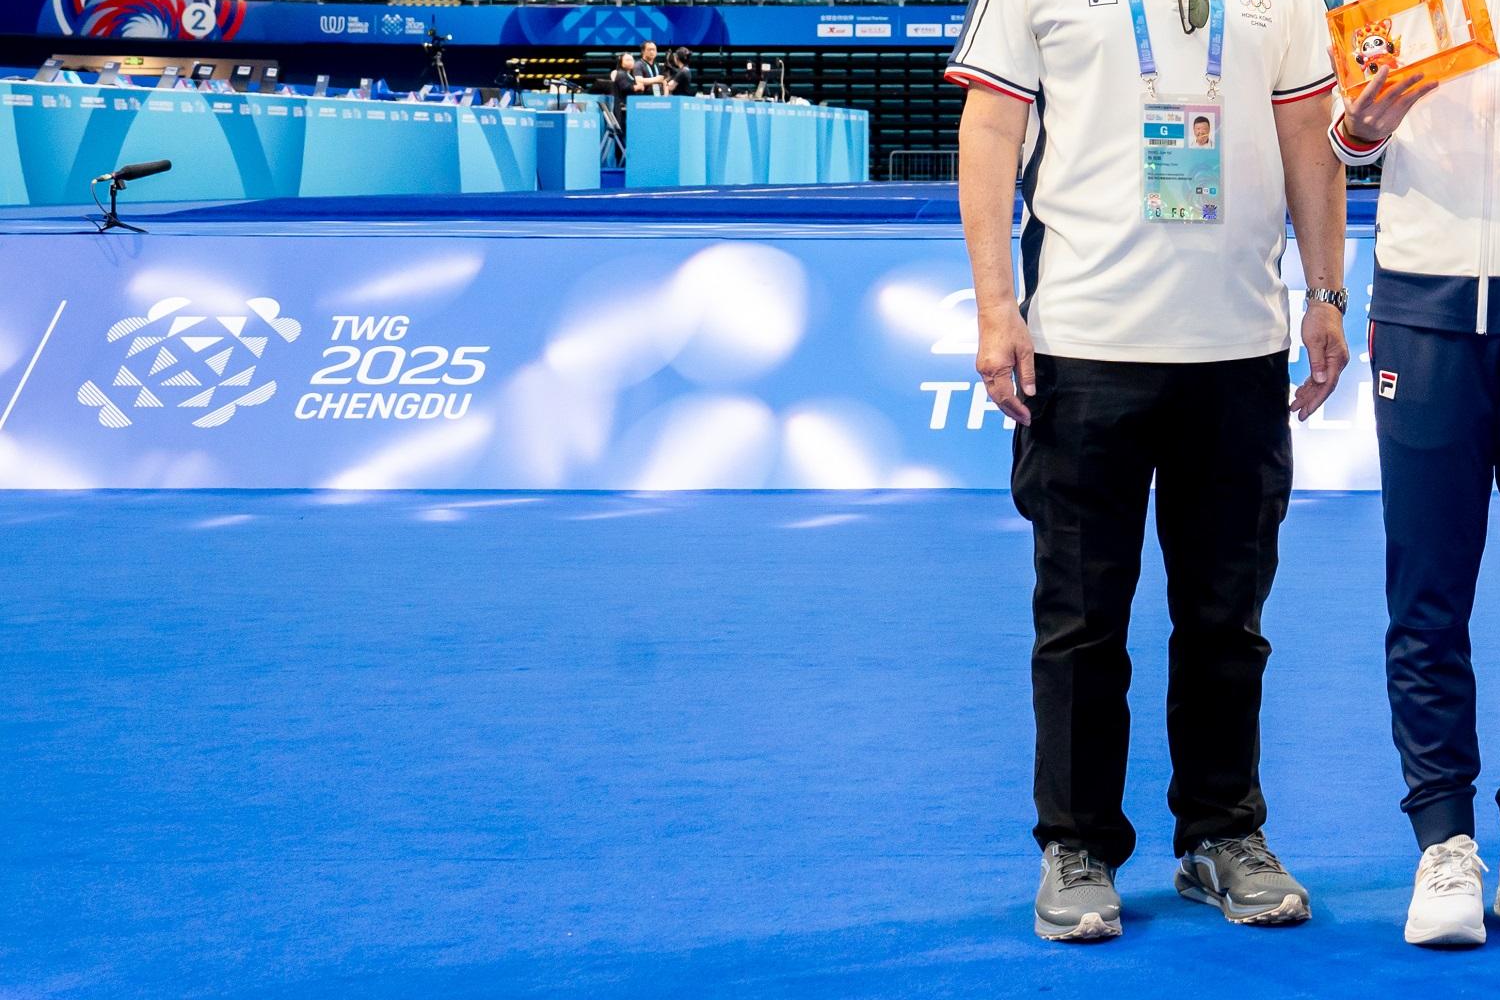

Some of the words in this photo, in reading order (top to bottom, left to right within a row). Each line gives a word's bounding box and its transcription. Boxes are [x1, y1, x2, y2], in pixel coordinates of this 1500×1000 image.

[191, 9, 206, 30] 2
[1160, 125, 1168, 136] G
[331, 315, 410, 341] TWG
[310, 346, 490, 385] 2025
[294, 392, 472, 420] CHENGDU
